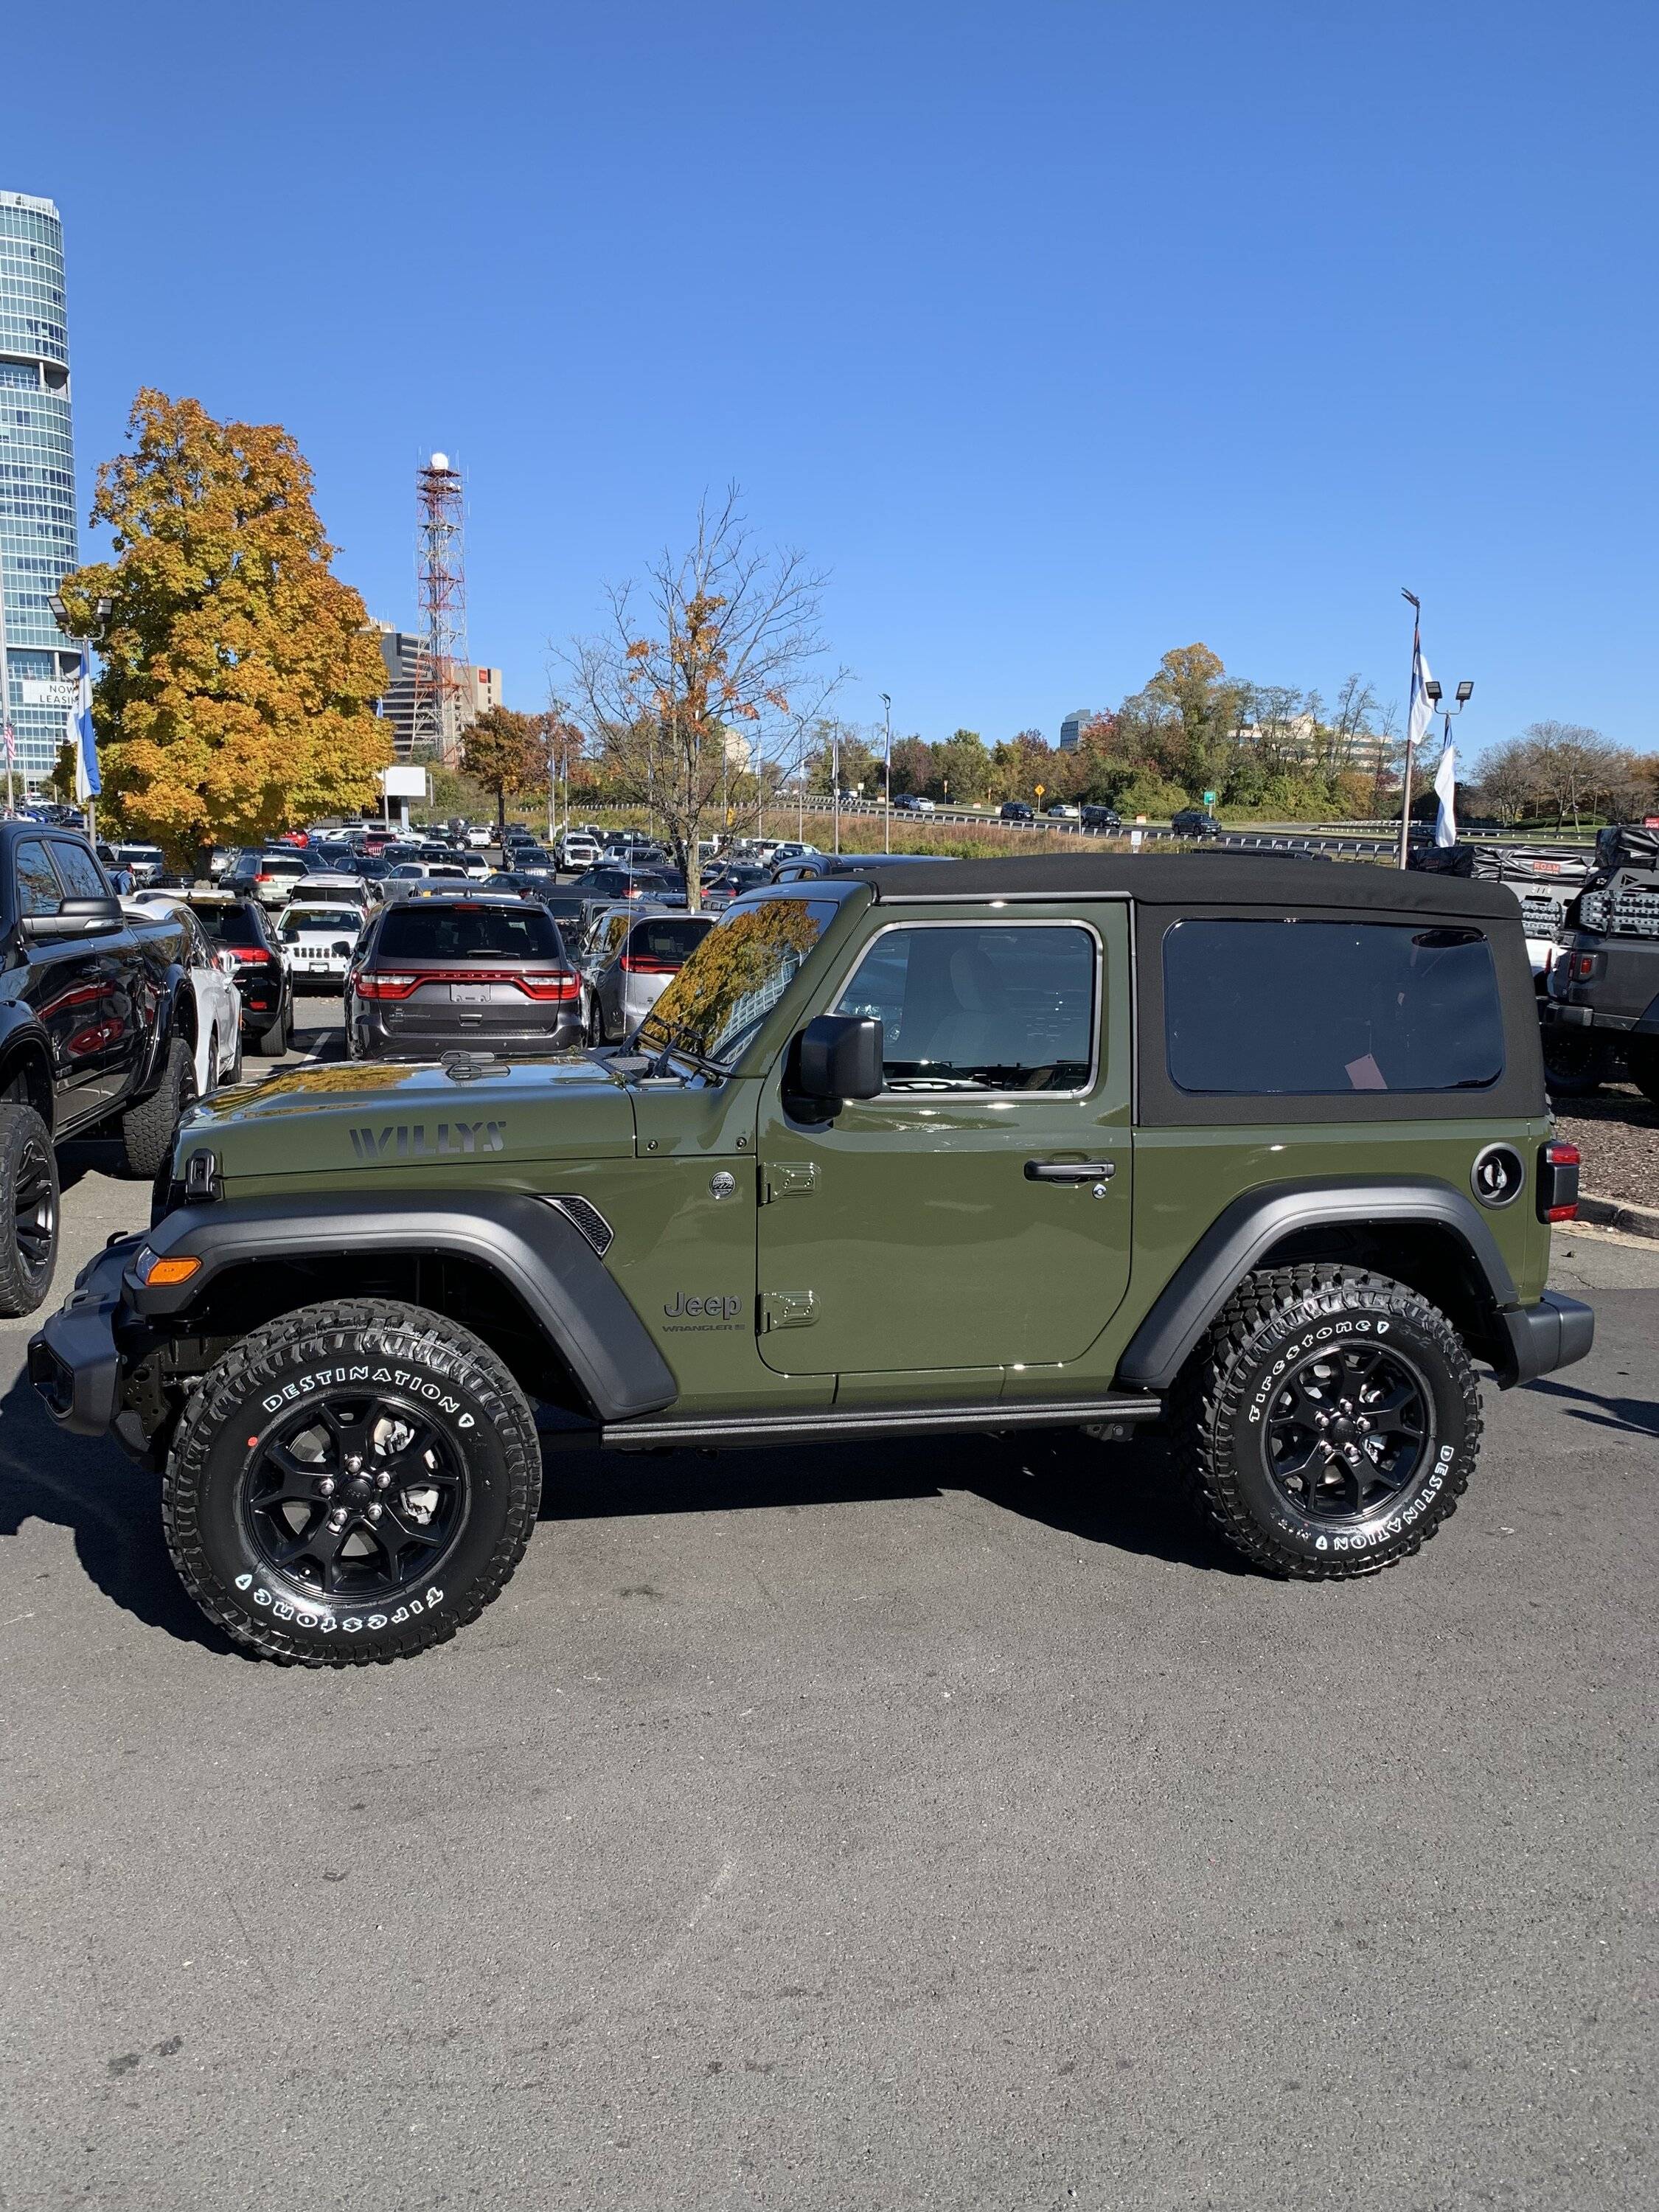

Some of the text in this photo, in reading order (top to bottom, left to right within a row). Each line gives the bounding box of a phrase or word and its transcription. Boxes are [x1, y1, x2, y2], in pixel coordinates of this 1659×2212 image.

[49, 684, 74, 694] NOW
[349, 1121, 507, 1158] WILLYS
[664, 1291, 742, 1320] Jeep
[662, 1324, 733, 1332] WRANGLER
[262, 1366, 460, 1413] DESTINATION
[1334, 1445, 1454, 1551] DESTINATION
